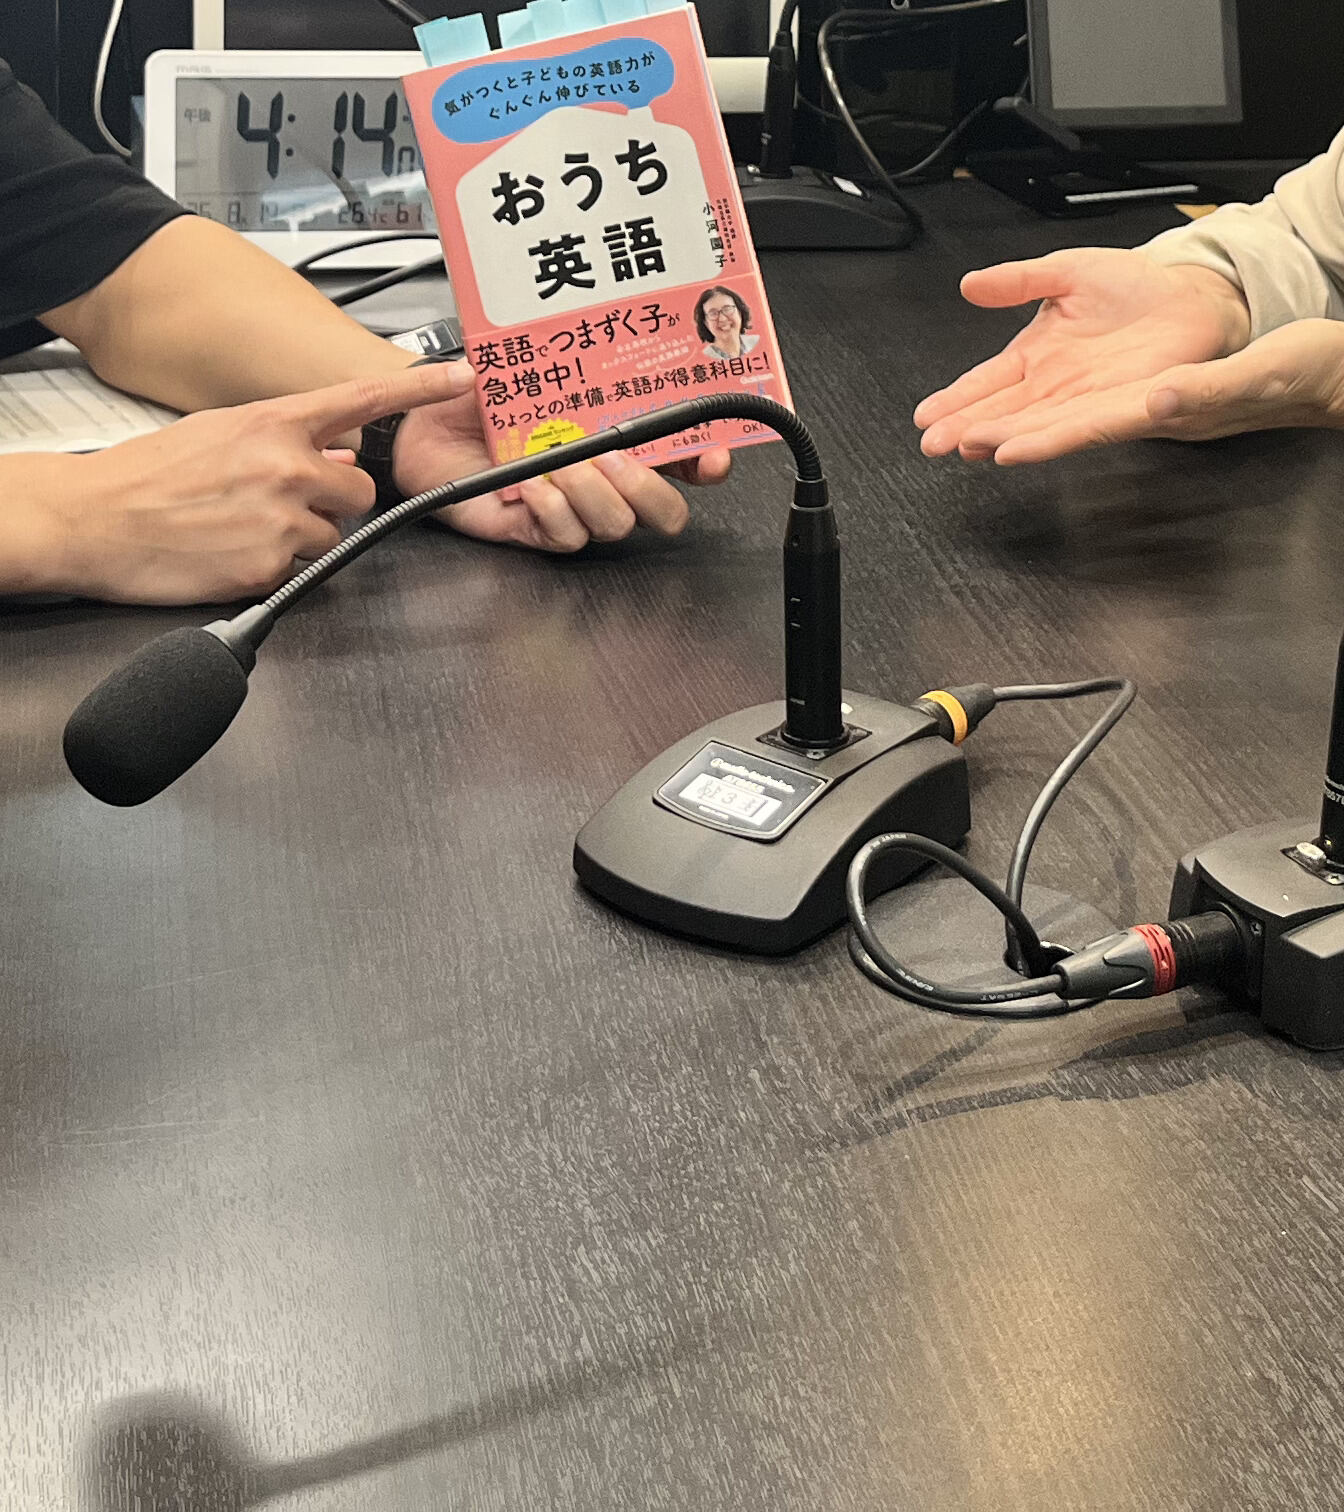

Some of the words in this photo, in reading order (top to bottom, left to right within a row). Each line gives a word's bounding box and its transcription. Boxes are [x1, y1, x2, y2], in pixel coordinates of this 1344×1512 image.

[443, 50, 656, 118] 気がつくと子どもの英語力が
[487, 79, 642, 121] ぐんぐん伸びている
[236, 90, 399, 180] 4:14
[491, 138, 670, 227] おうち
[528, 216, 667, 300] 英語
[473, 302, 681, 374] 英語でつまずく子が
